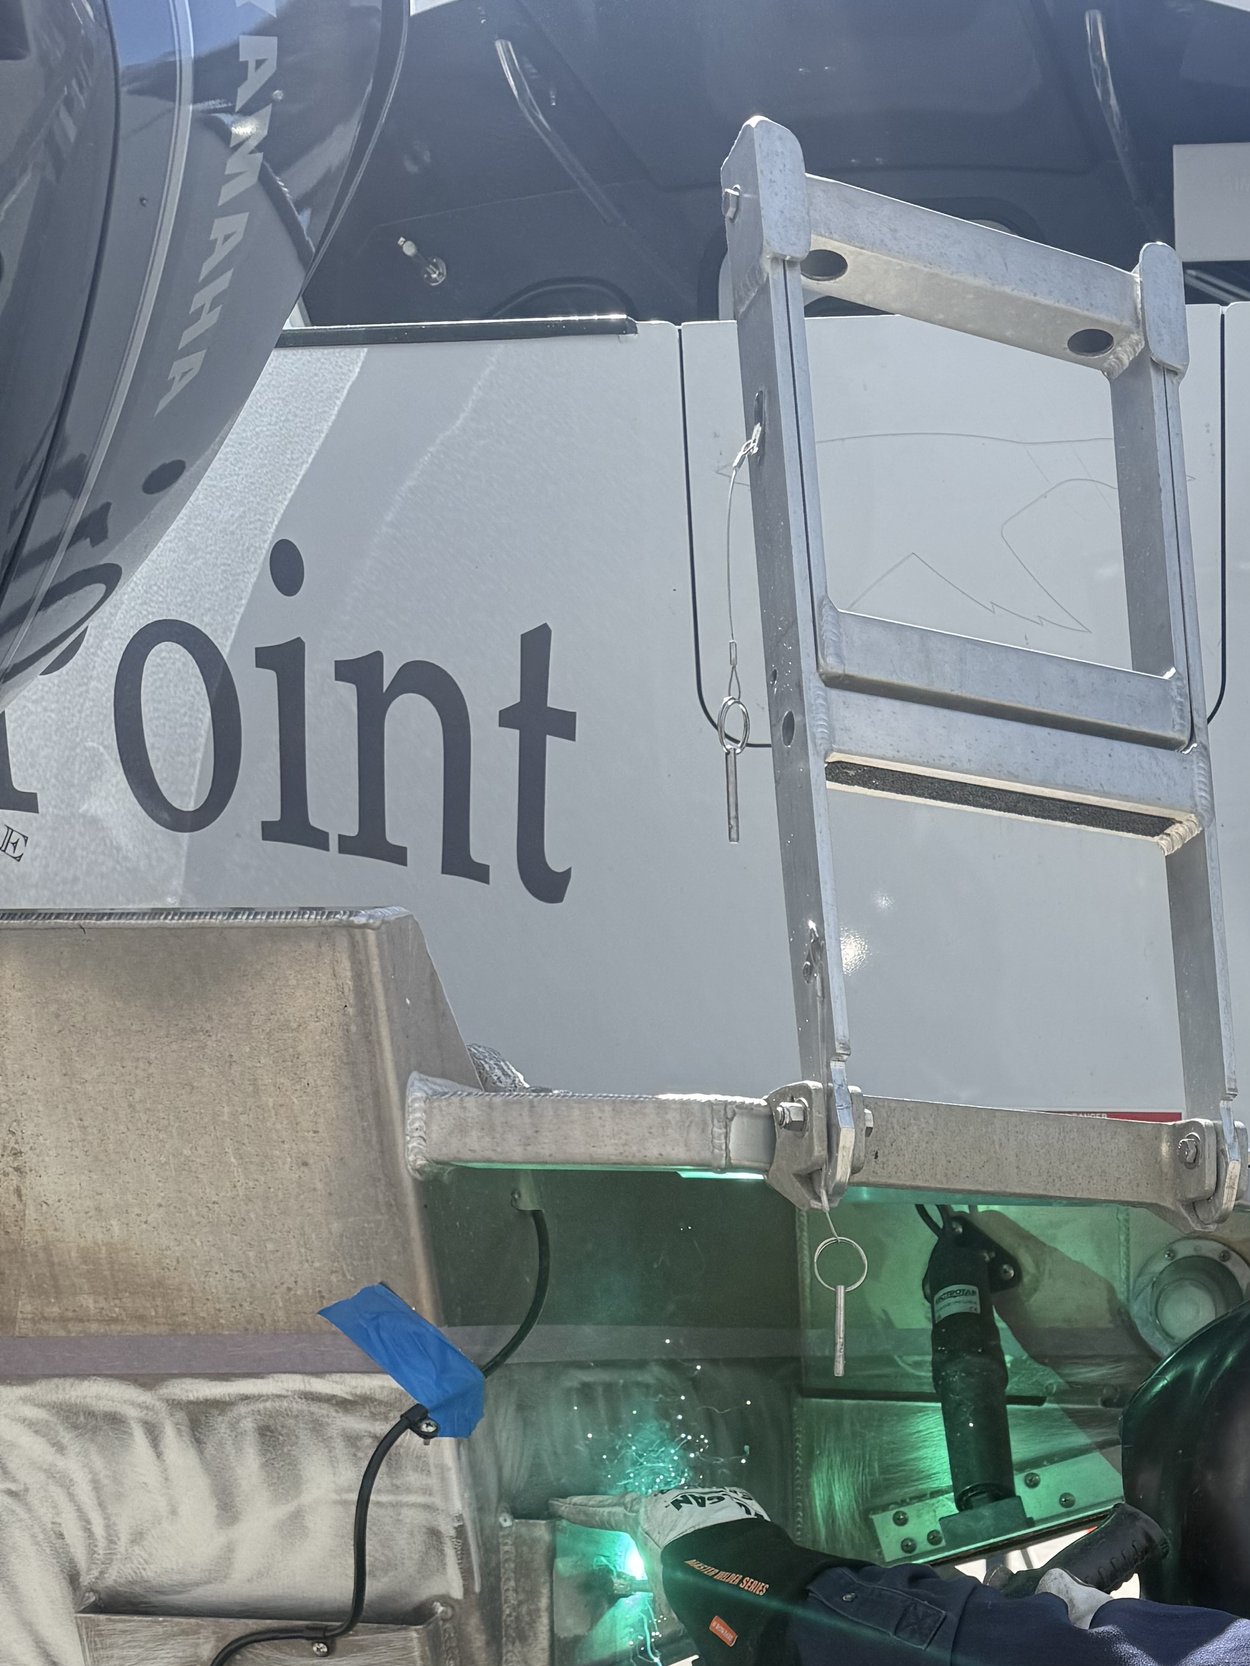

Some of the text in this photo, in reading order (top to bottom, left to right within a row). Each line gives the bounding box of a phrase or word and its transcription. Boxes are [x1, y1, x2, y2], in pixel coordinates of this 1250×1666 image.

[155, 0, 278, 418] AMAHA
[0, 538, 577, 904] oint
[739, 1576, 770, 1596] SERIES
